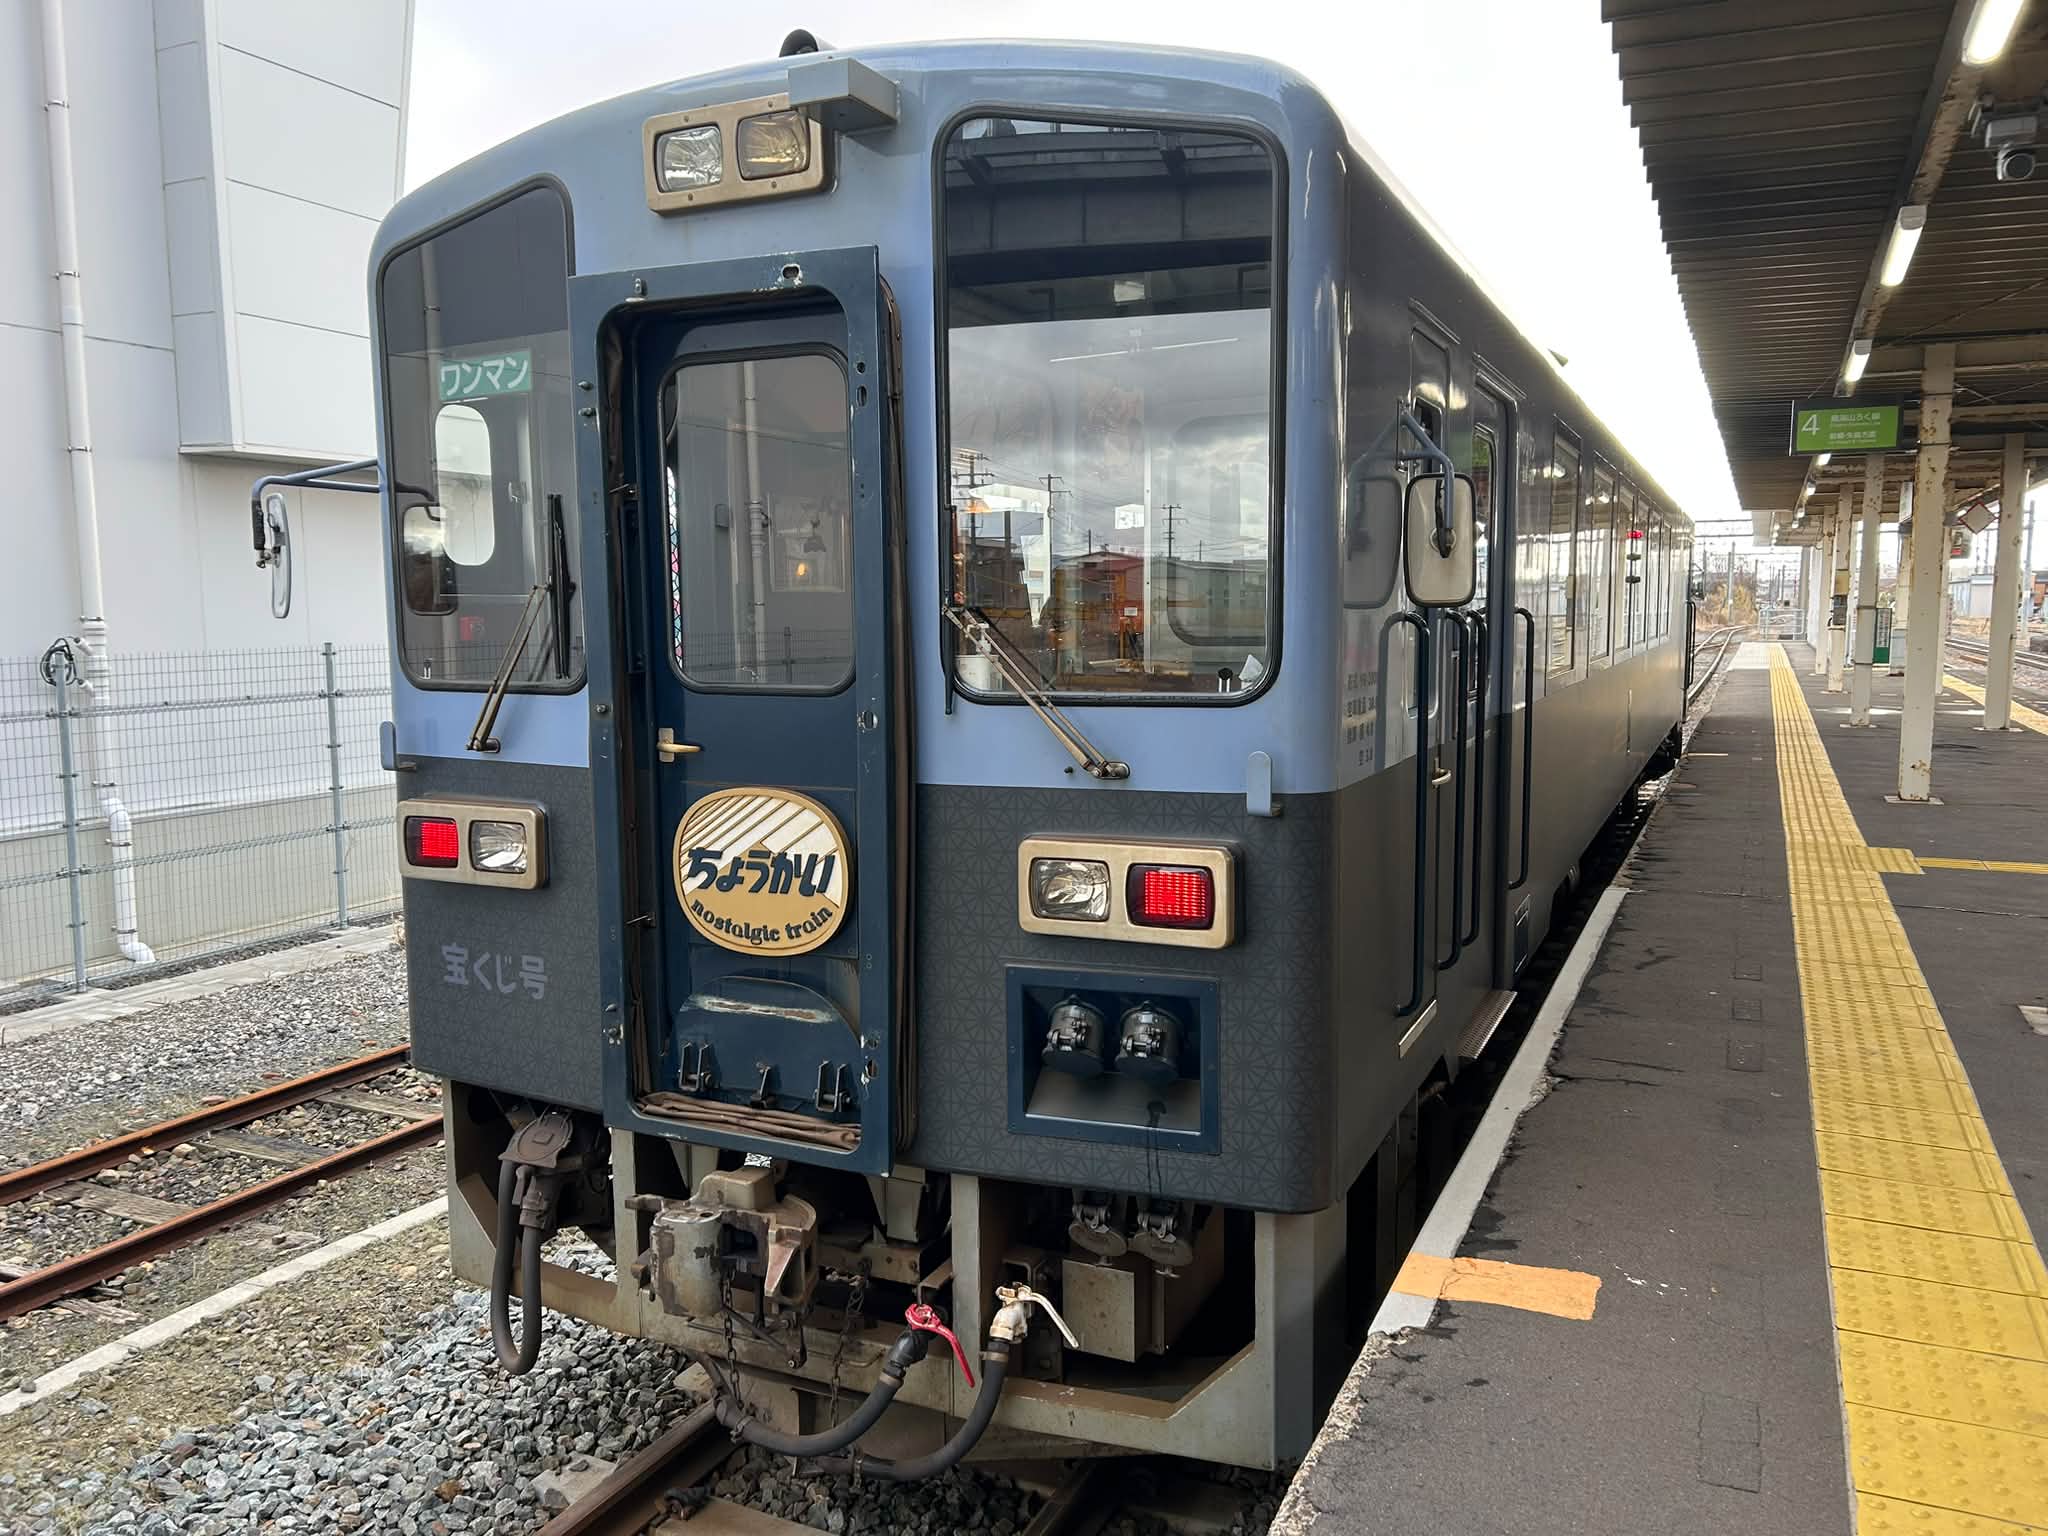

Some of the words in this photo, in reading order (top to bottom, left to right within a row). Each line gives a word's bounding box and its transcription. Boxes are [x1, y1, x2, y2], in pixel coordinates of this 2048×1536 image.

[440, 356, 529, 396] ワンマン
[1801, 413, 1821, 436] 4
[687, 846, 835, 897] ちょうかい
[691, 898, 780, 945] nostalgic
[785, 906, 833, 940] train
[441, 942, 548, 999] 宝くじ号
